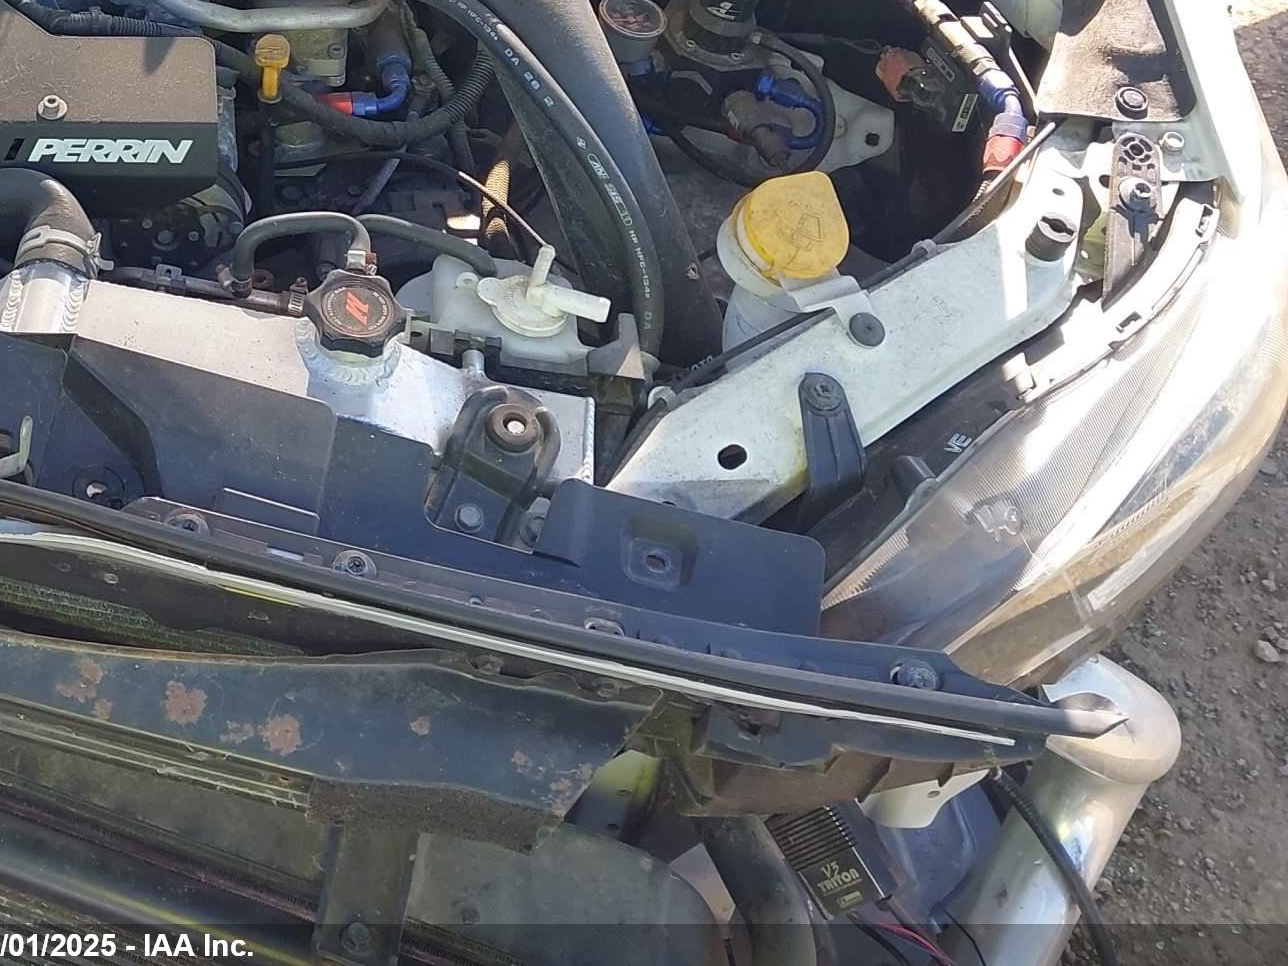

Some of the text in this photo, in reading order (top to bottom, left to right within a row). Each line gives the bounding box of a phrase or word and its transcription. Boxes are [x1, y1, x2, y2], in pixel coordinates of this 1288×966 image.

[504, 48, 520, 66] DA
[28, 138, 194, 164] PERRIN
[817, 868, 860, 892] TRITON
